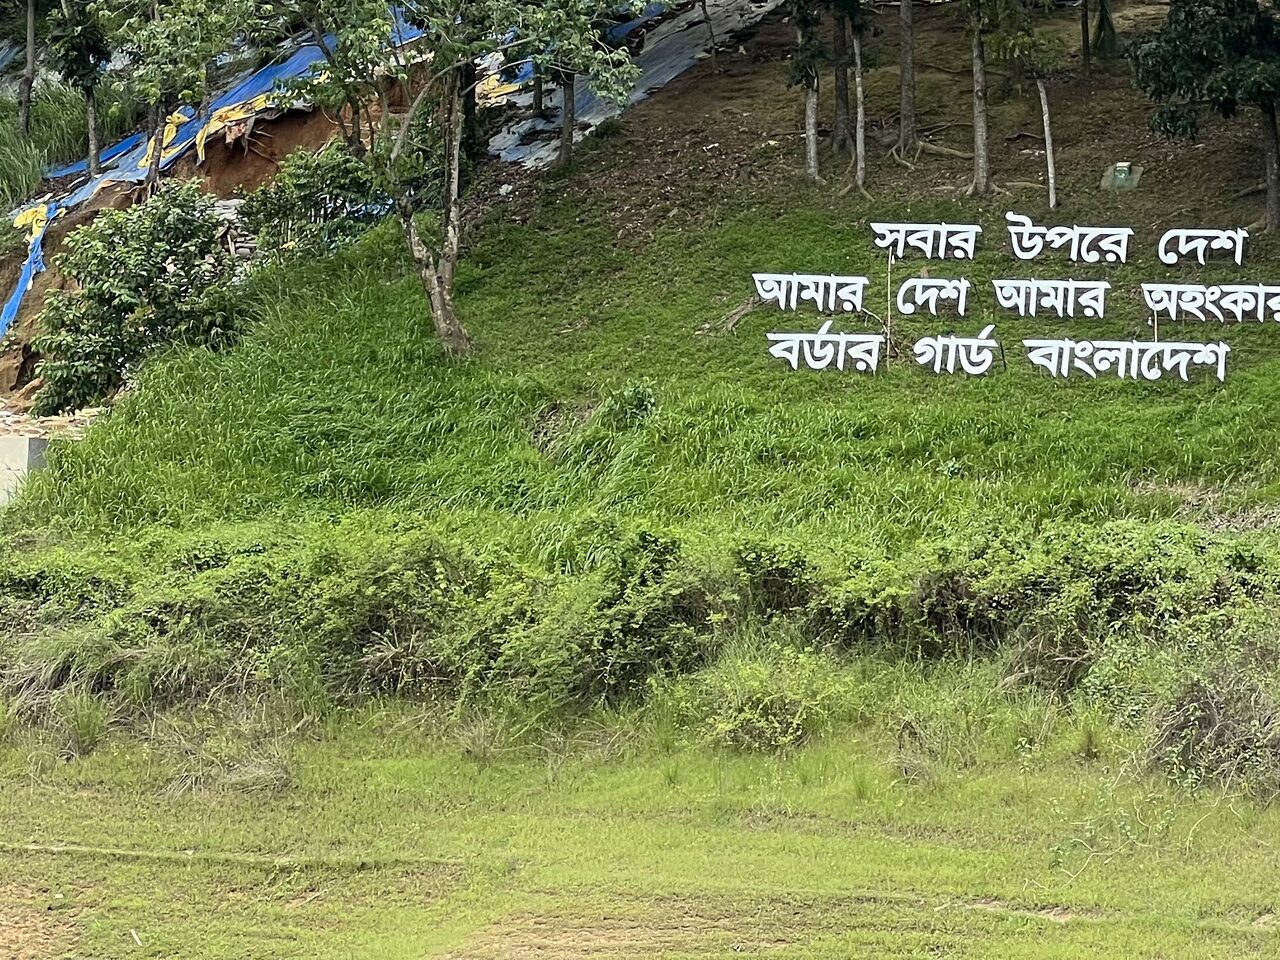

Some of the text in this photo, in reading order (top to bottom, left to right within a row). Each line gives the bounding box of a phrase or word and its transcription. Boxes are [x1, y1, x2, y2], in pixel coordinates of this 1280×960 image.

[870, 210, 1249, 267] সবার উপরে দেশ
[751, 273, 870, 313] আমার
[896, 277, 971, 317] দেশ
[991, 278, 1111, 319] আমার
[766, 319, 1232, 383] বর্ডার গার্ড বাংলাদেশ
